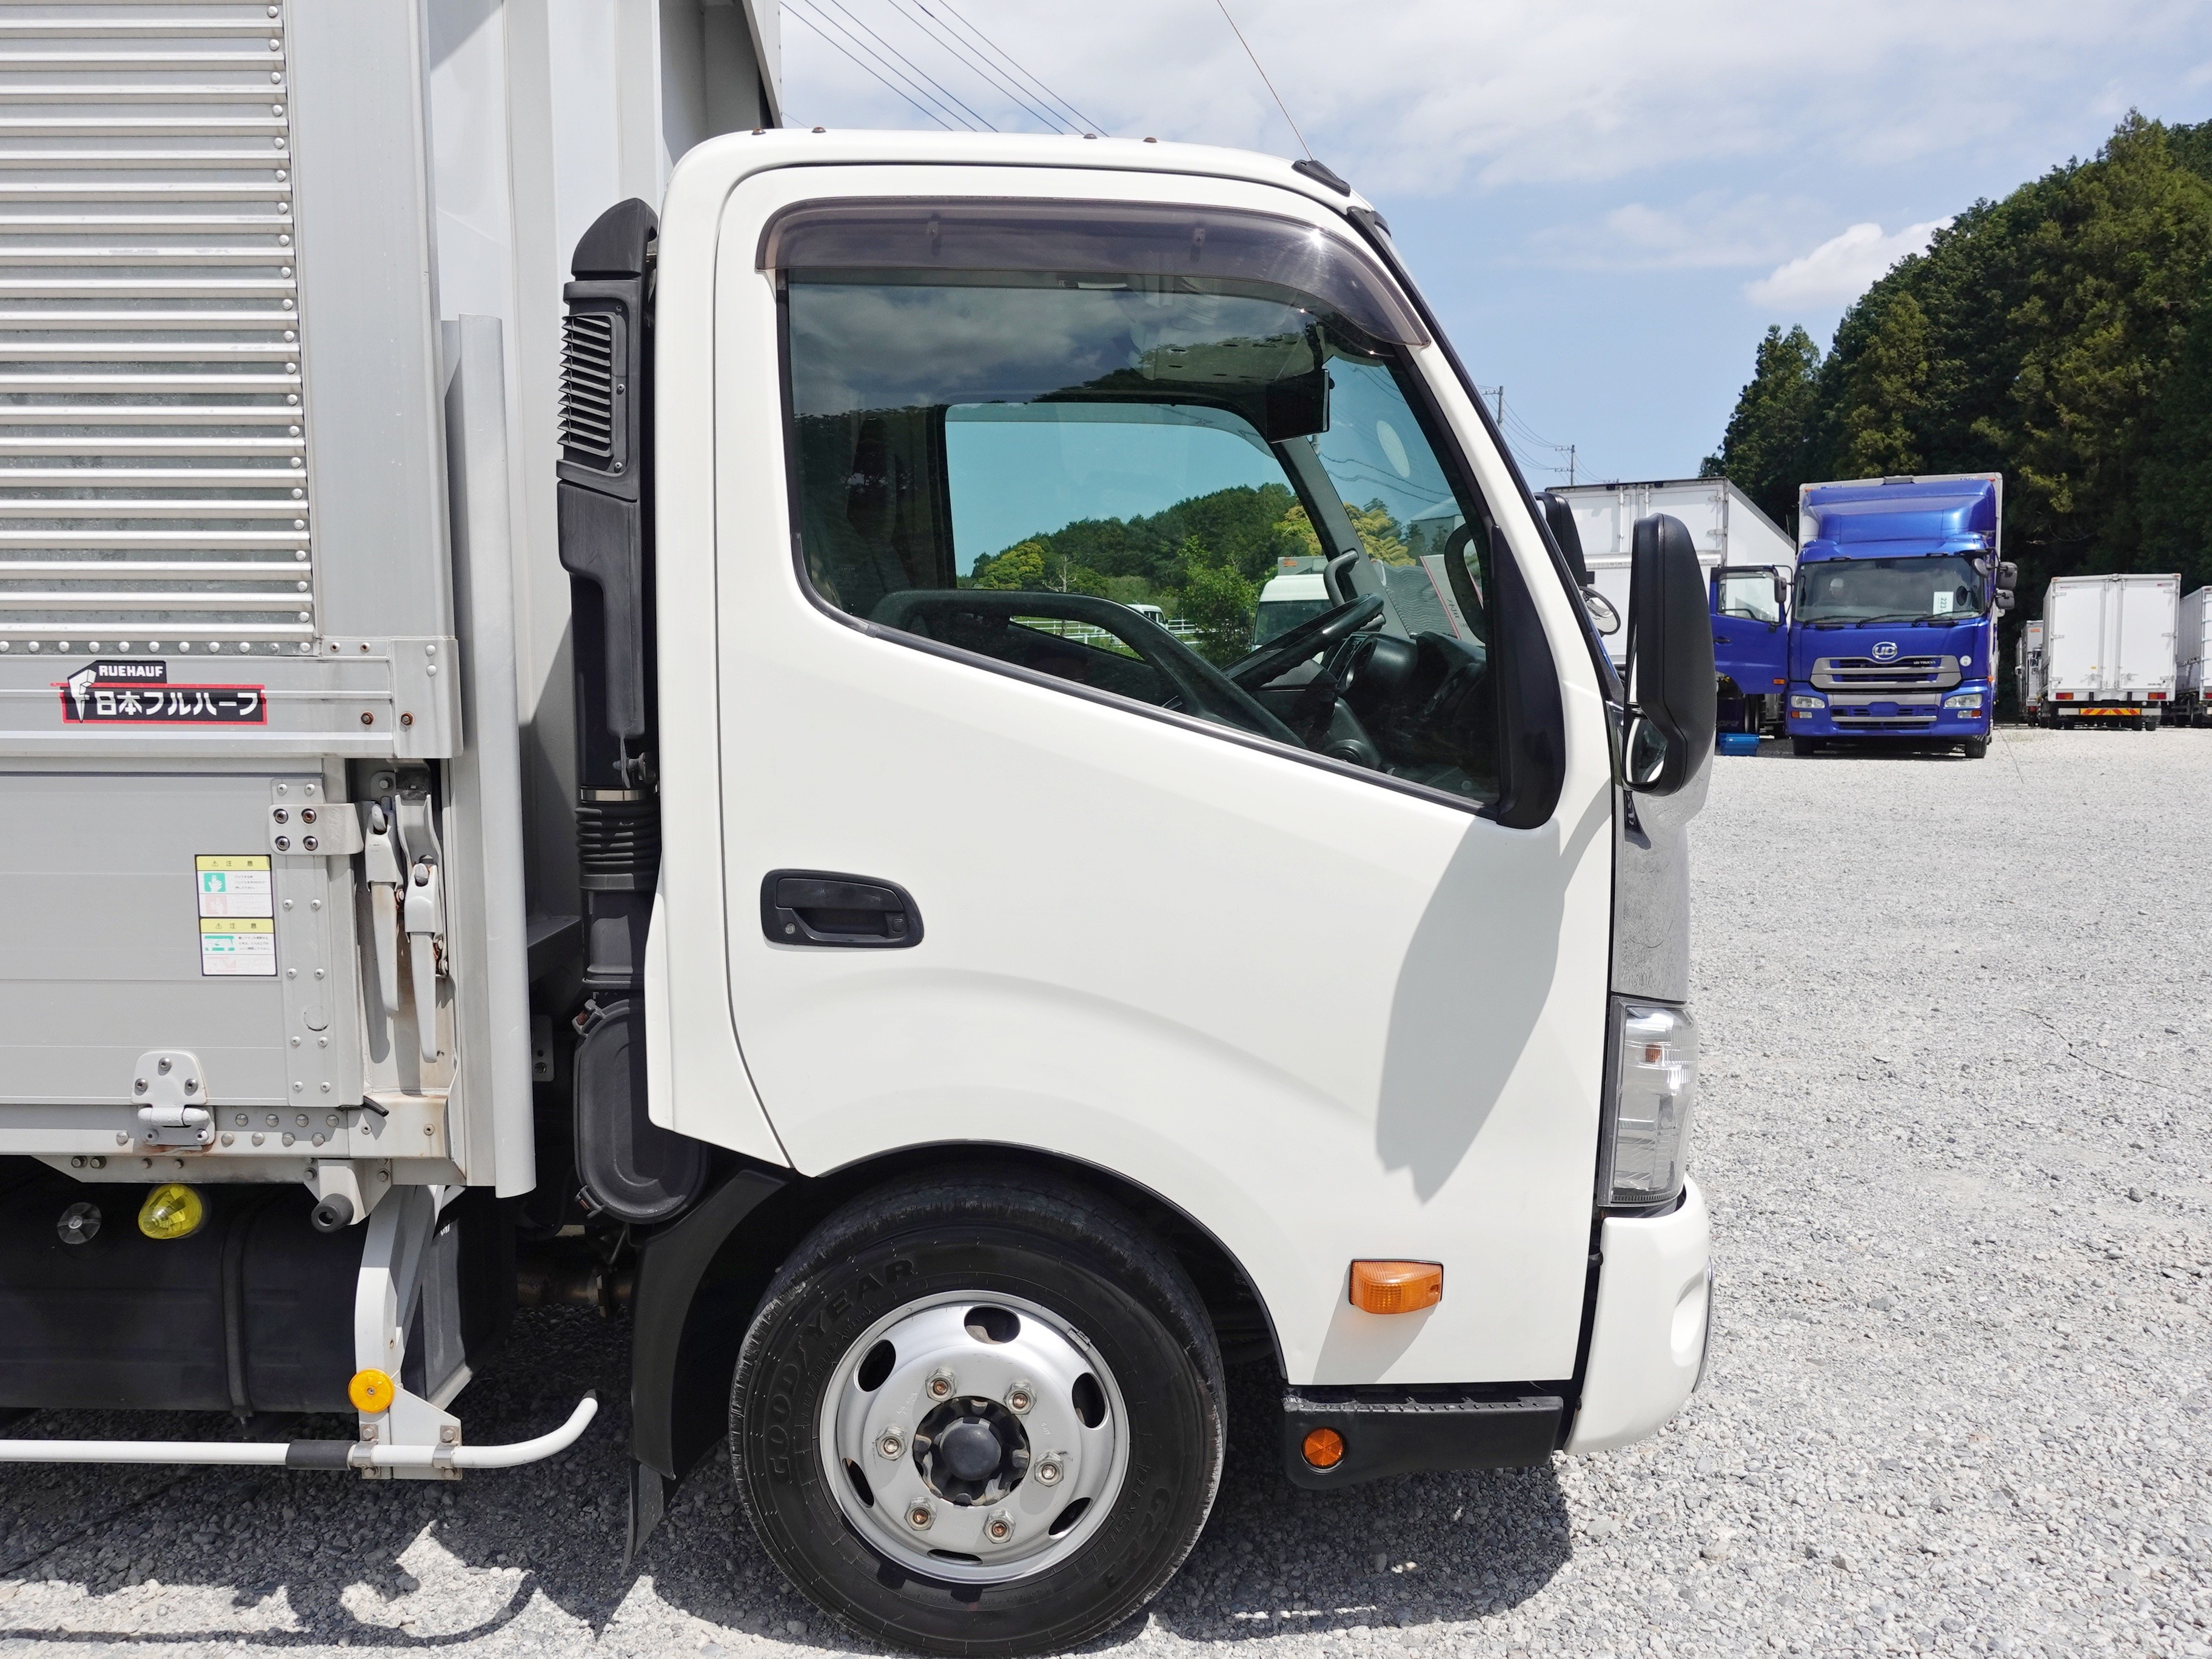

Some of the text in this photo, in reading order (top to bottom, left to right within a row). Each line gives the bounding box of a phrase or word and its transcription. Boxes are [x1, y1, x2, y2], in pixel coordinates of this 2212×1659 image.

[94, 691, 258, 716] 日本フルハーフ
